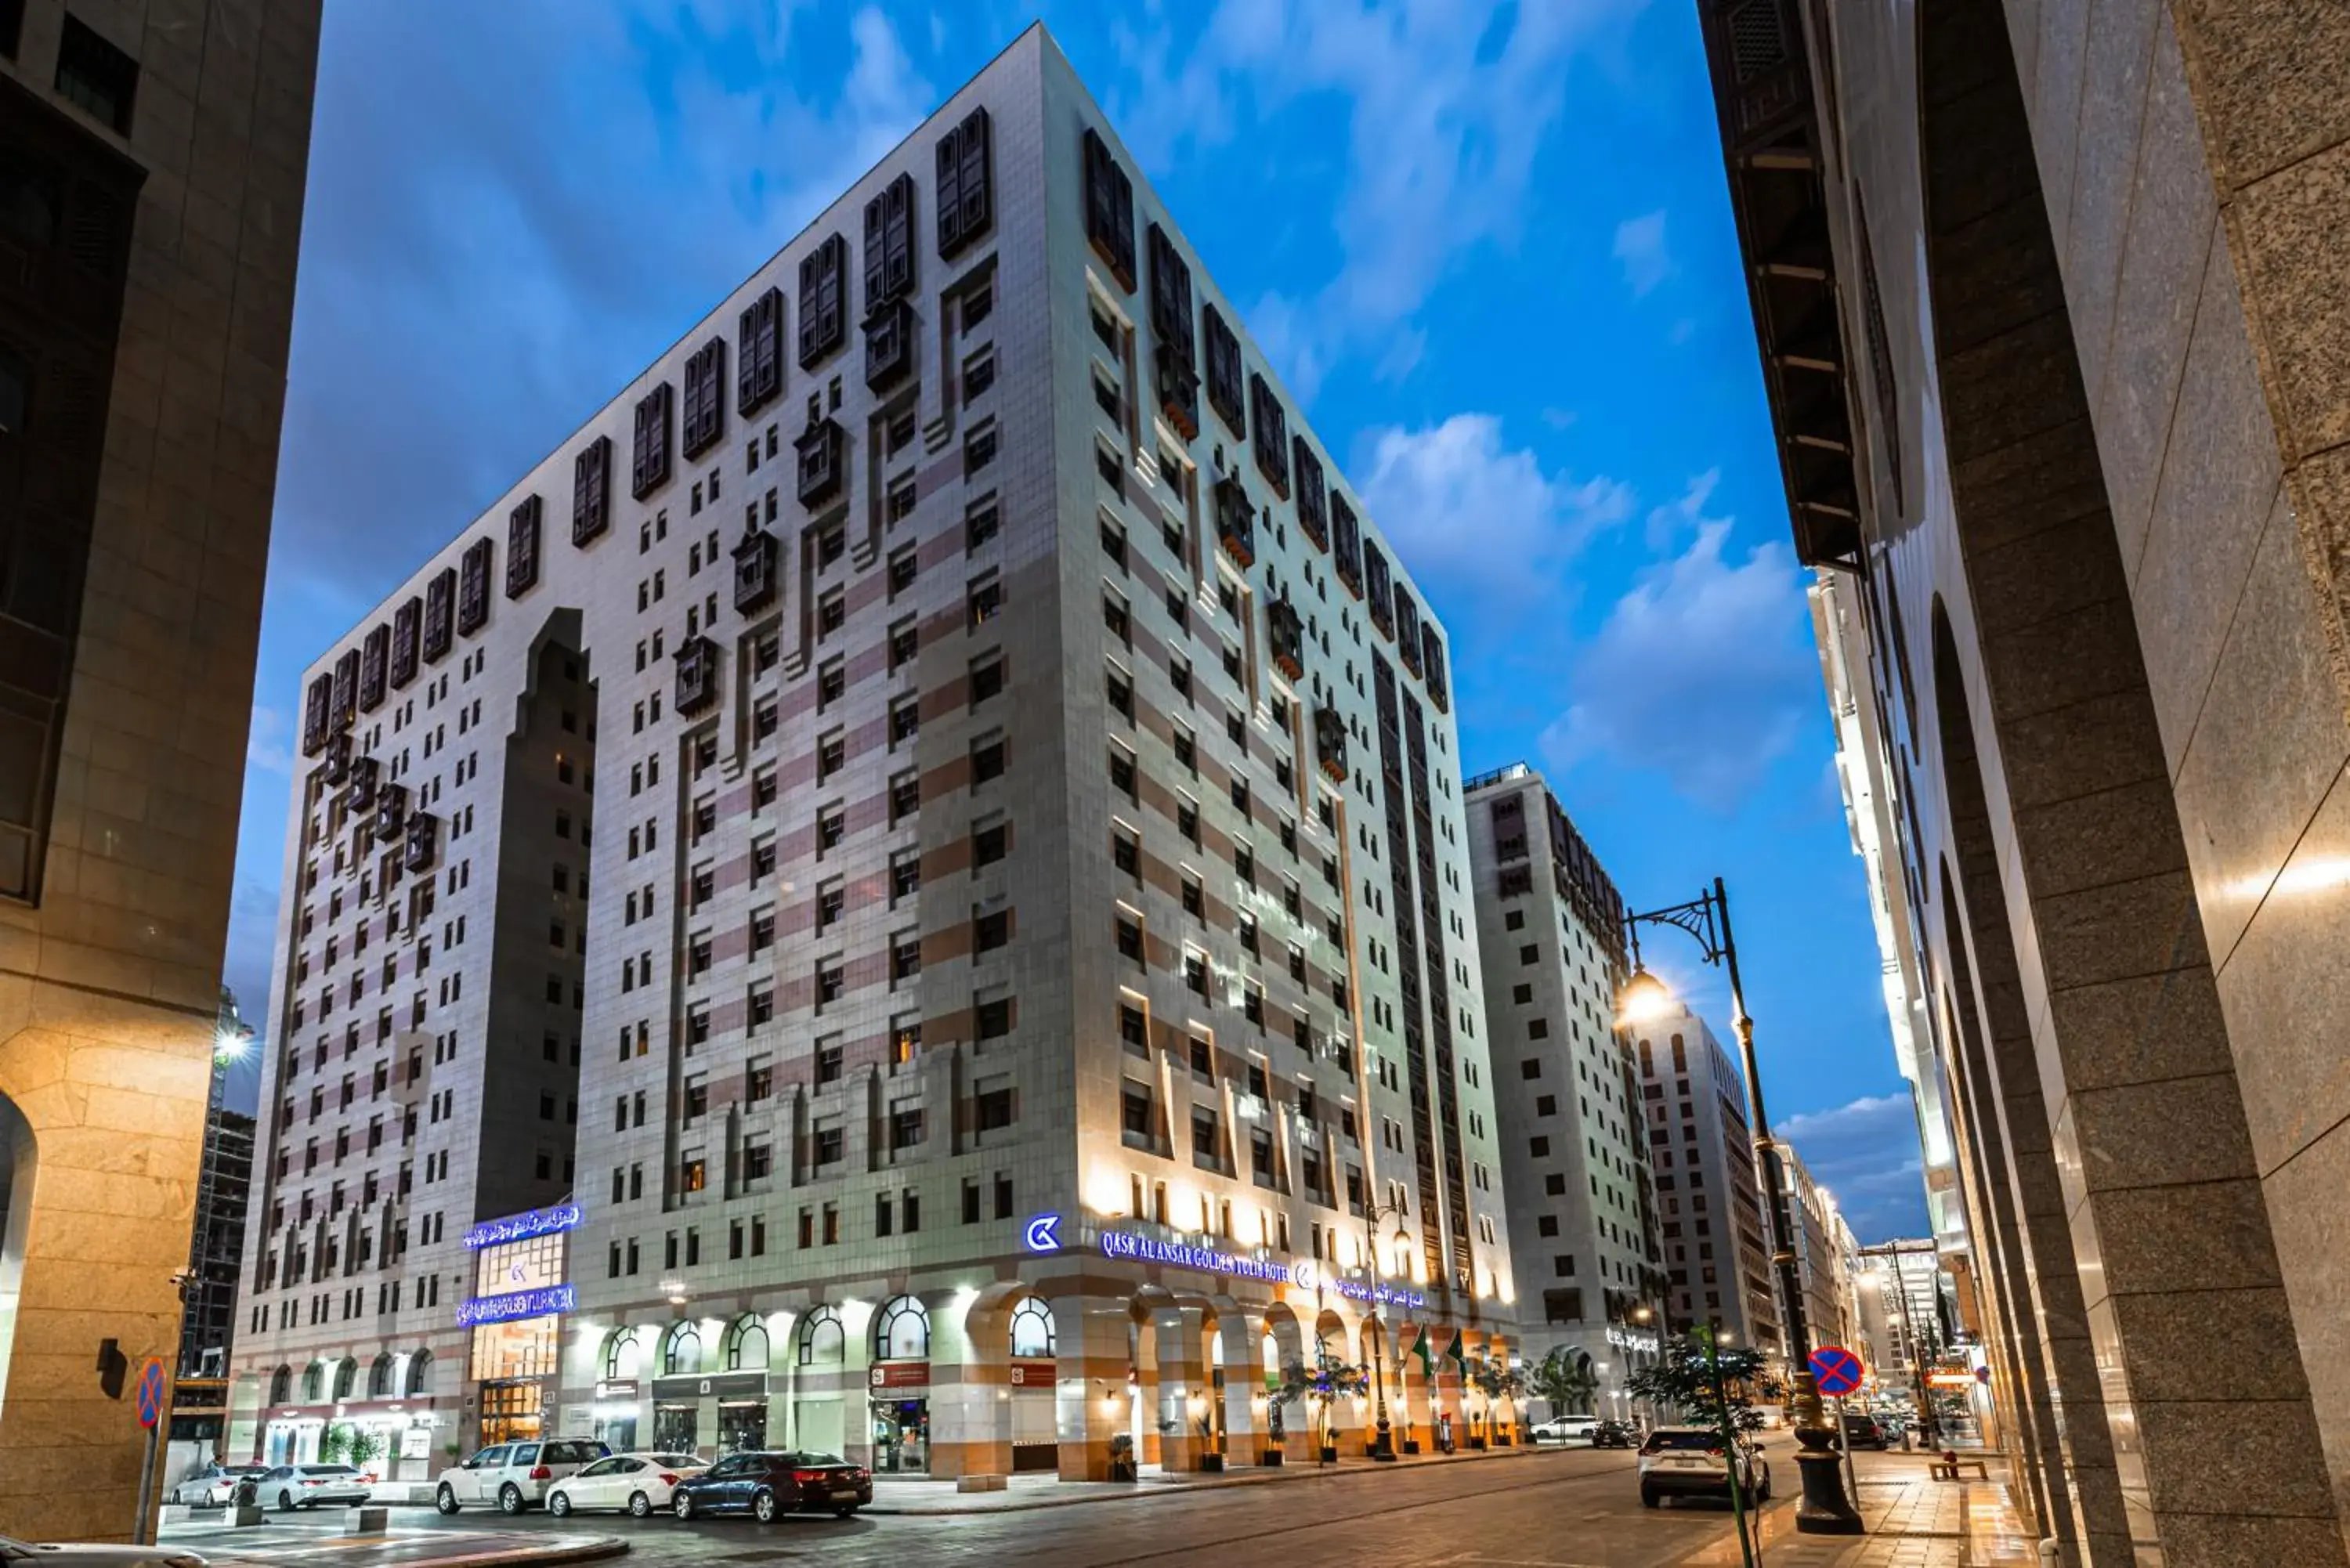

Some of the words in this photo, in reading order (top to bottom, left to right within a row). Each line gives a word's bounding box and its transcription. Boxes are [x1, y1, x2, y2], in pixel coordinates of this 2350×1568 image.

[1104, 1232, 1136, 1258] QASR
[1157, 1241, 1191, 1265] ANSAR
[1194, 1247, 1235, 1273] GOLDEN
